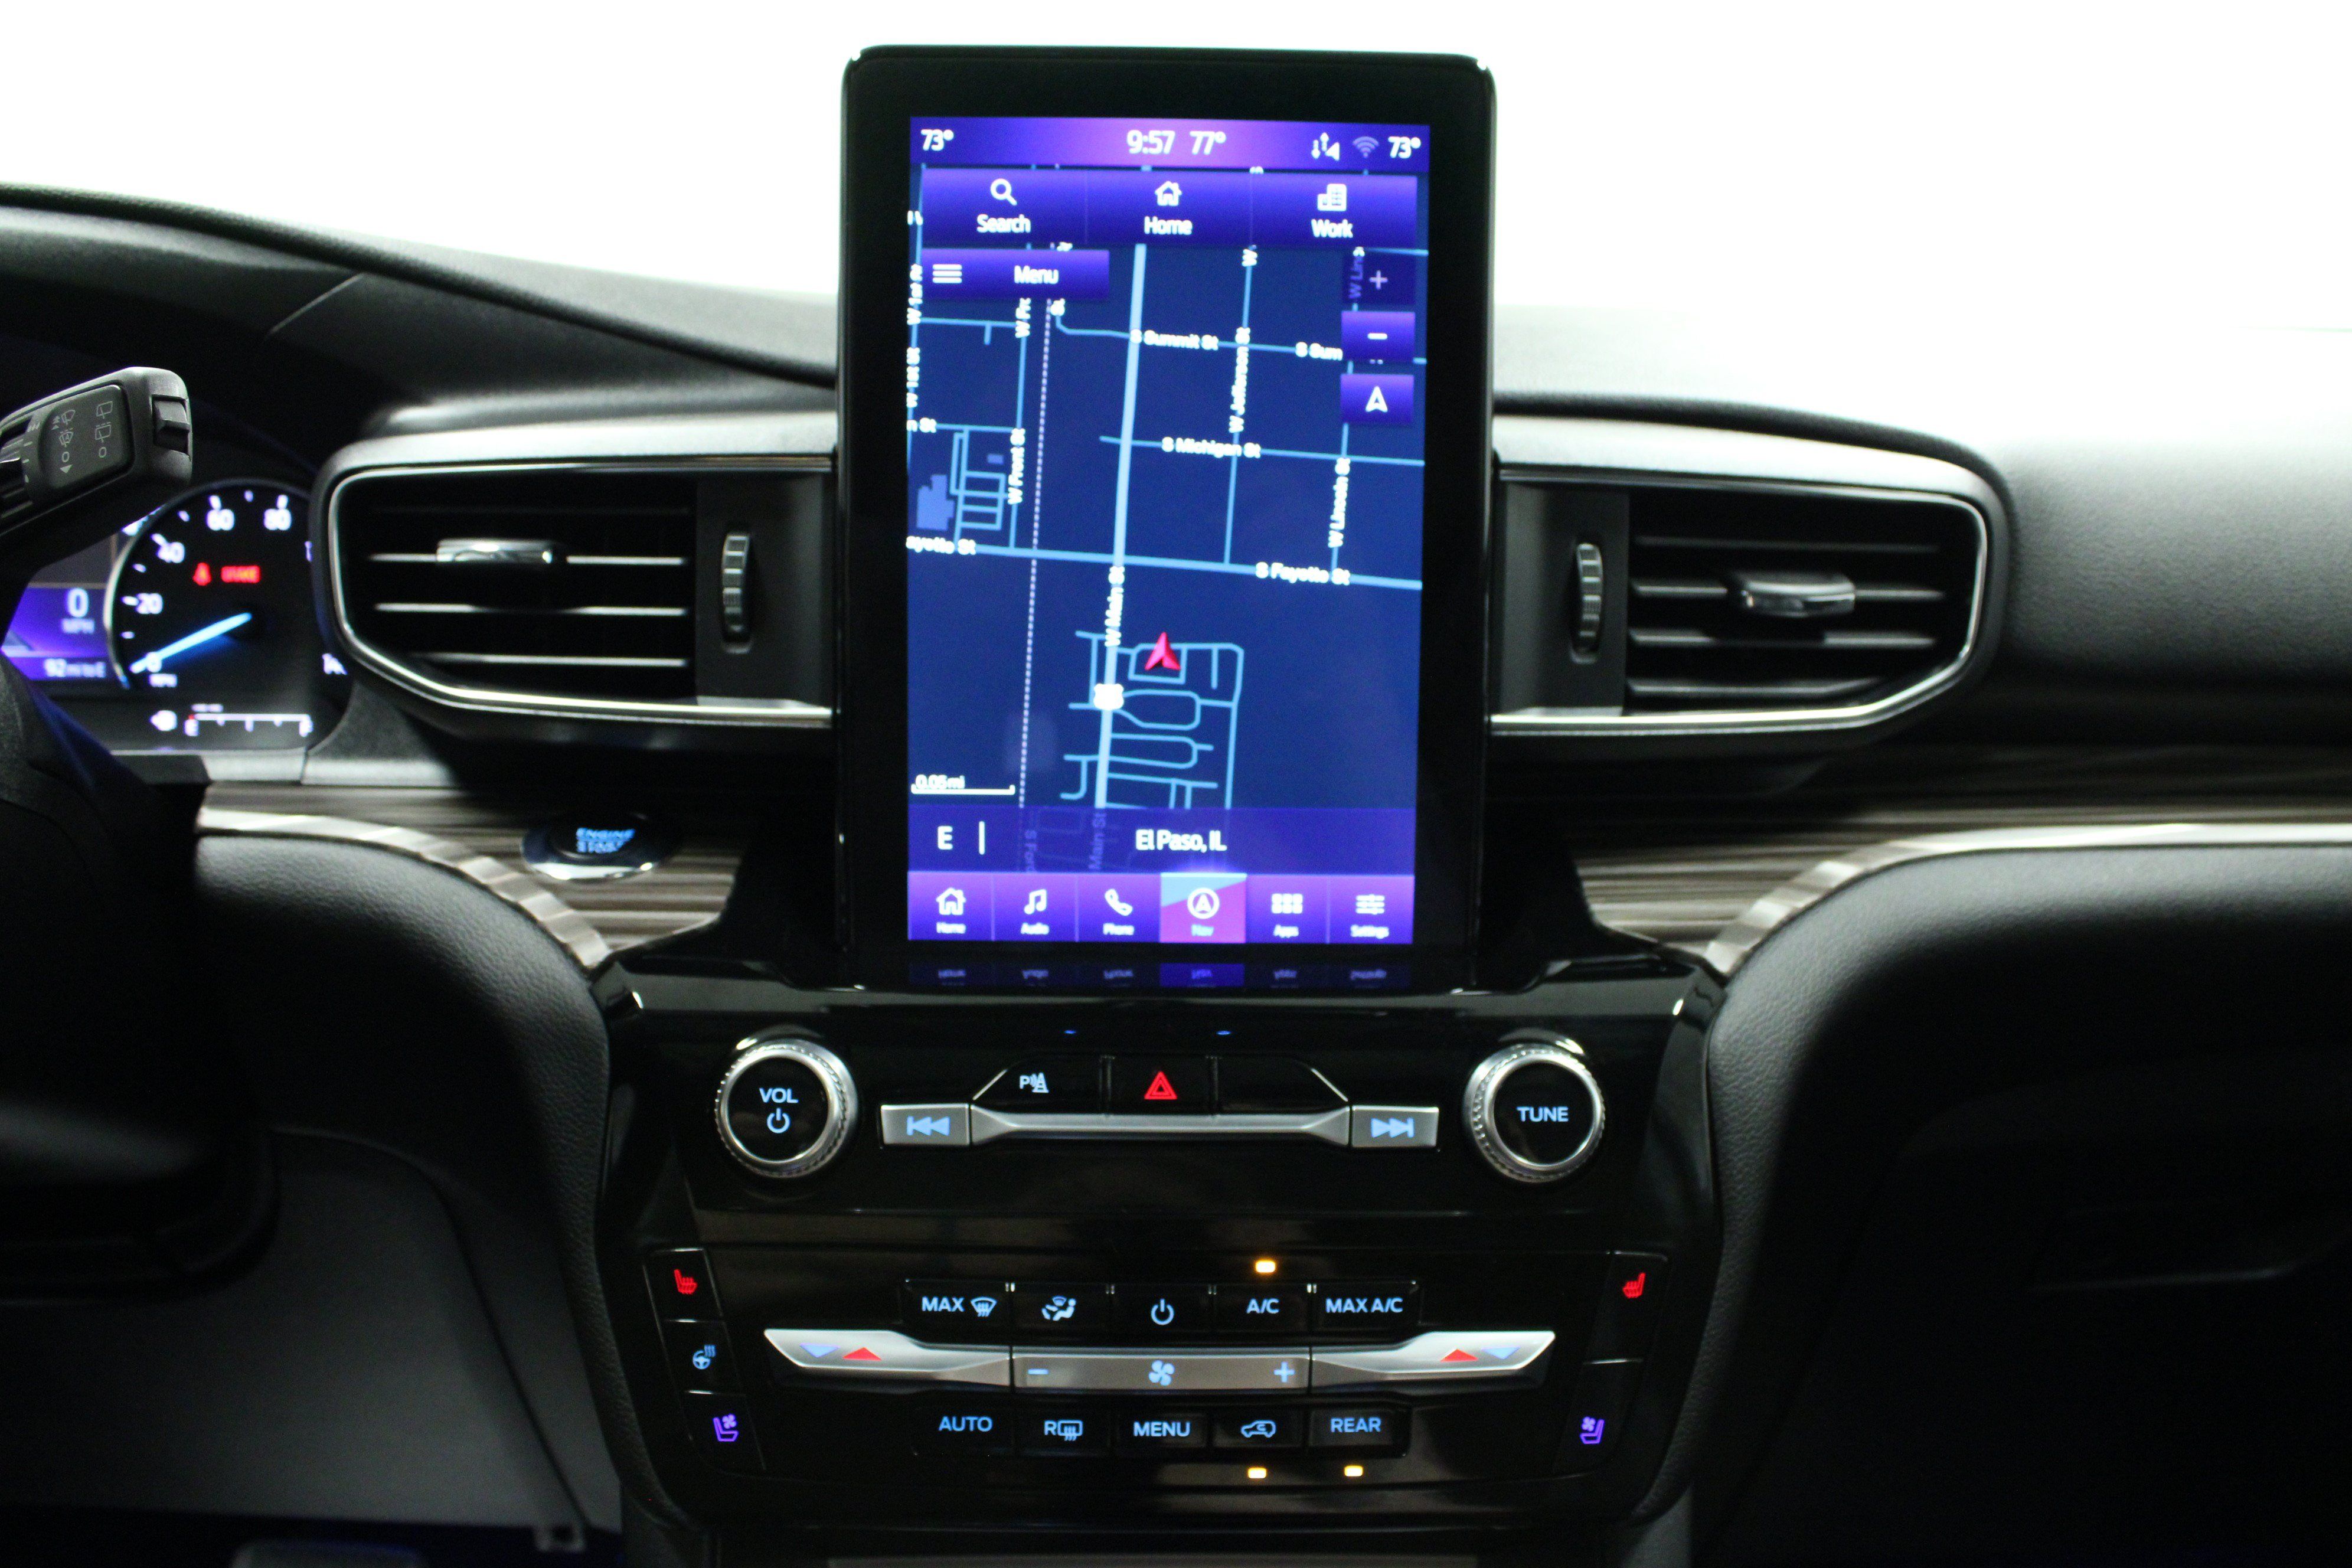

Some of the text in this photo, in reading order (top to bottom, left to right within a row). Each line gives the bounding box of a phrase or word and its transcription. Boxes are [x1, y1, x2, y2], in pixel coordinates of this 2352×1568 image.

[921, 129, 954, 151] 73°
[1127, 130, 1226, 154] 9:57 77°
[1389, 136, 1422, 159] 73°
[977, 214, 1031, 233] Search
[1145, 216, 1192, 236] Home
[1311, 218, 1354, 238] Work
[1014, 265, 1059, 284] Menu
[1144, 330, 1200, 349] Summit
[1230, 346, 1249, 416] Jefferson
[1175, 437, 1242, 458] Michigan
[1008, 447, 1025, 486] Front
[1329, 476, 1349, 530] Lincoln
[1270, 562, 1329, 583] Fayette
[66, 587, 89, 618] 0
[136, 593, 163, 615] 20
[1105, 586, 1123, 627] Main
[937, 826, 953, 850] E
[1136, 829, 1227, 853] El Paso, IL
[1350, 925, 1390, 939] Settings
[759, 1087, 798, 1103] VOL
[1517, 1106, 1569, 1122] TUNE
[922, 1297, 964, 1312] MAX
[1247, 1298, 1279, 1315] A/C
[1325, 1298, 1403, 1314] MAX A/C
[938, 1416, 992, 1432] AUTO
[1133, 1422, 1190, 1437] MENU
[1331, 1417, 1381, 1433] REAR
